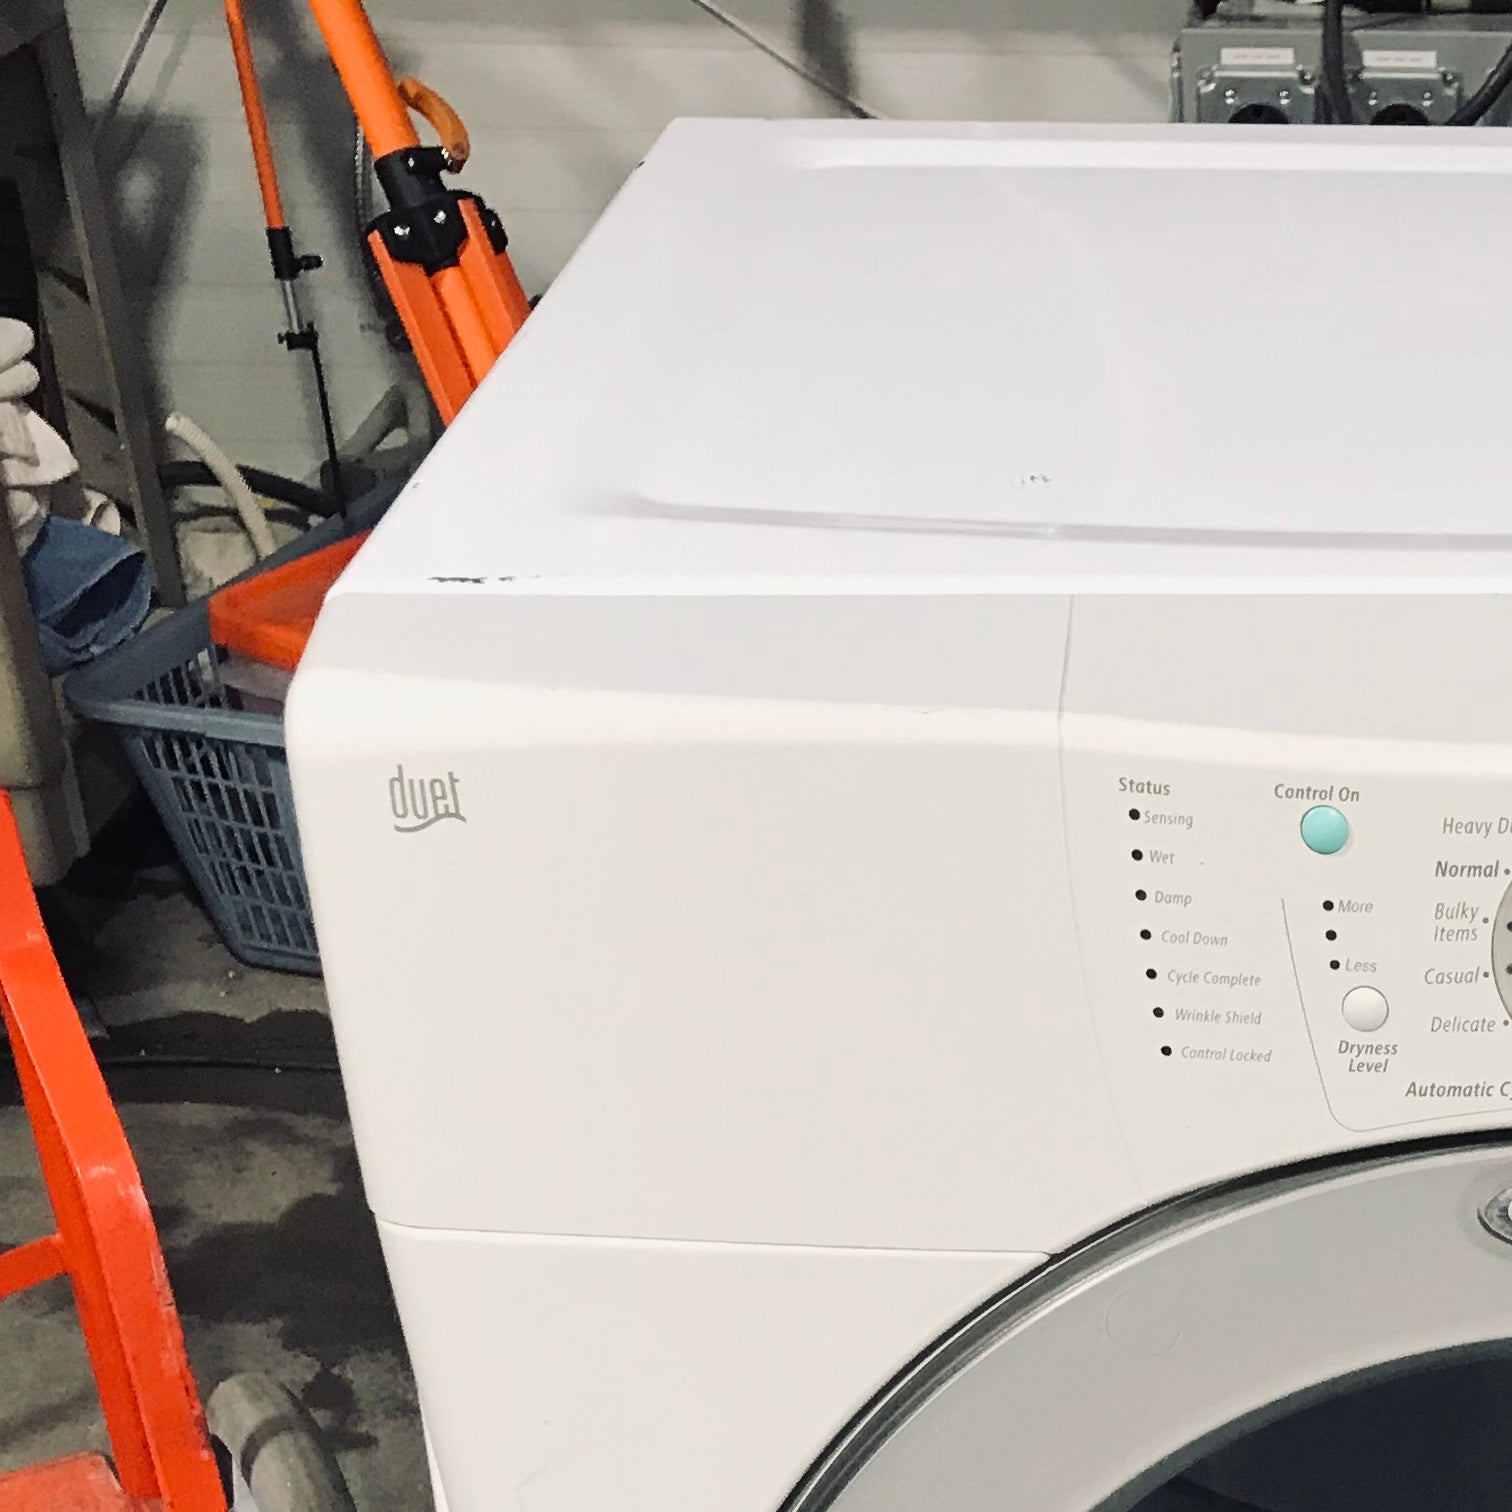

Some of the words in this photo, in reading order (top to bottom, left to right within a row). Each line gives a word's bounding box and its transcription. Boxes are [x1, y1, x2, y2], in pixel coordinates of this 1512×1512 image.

[389, 763, 467, 826] duet
[1118, 777, 1170, 796] Status
[1274, 783, 1333, 801] Control
[1338, 786, 1360, 802] On
[1144, 810, 1193, 829] Sensing
[1442, 818, 1492, 836] Heavy
[1149, 850, 1174, 864] Wet
[1435, 860, 1499, 878] Normal
[1155, 891, 1192, 908] Damp
[1338, 900, 1373, 913] More
[1434, 903, 1478, 923] Bulky
[1162, 930, 1189, 945] Cool
[1193, 933, 1228, 946] Down
[1434, 925, 1478, 942] Items
[1345, 958, 1377, 972] Less
[1168, 969, 1200, 985] Cycle
[1204, 971, 1261, 988] Complete
[1424, 968, 1479, 985] Casual
[1175, 1008, 1221, 1023] Wrinkle
[1225, 1010, 1262, 1025] Shield
[1431, 1016, 1496, 1033] Delicate
[1181, 1046, 1226, 1061] Control
[1230, 1048, 1272, 1063] Locked
[1338, 1040, 1398, 1056] Dryness
[1349, 1058, 1388, 1073] Level
[1405, 1081, 1495, 1098] Automatic
